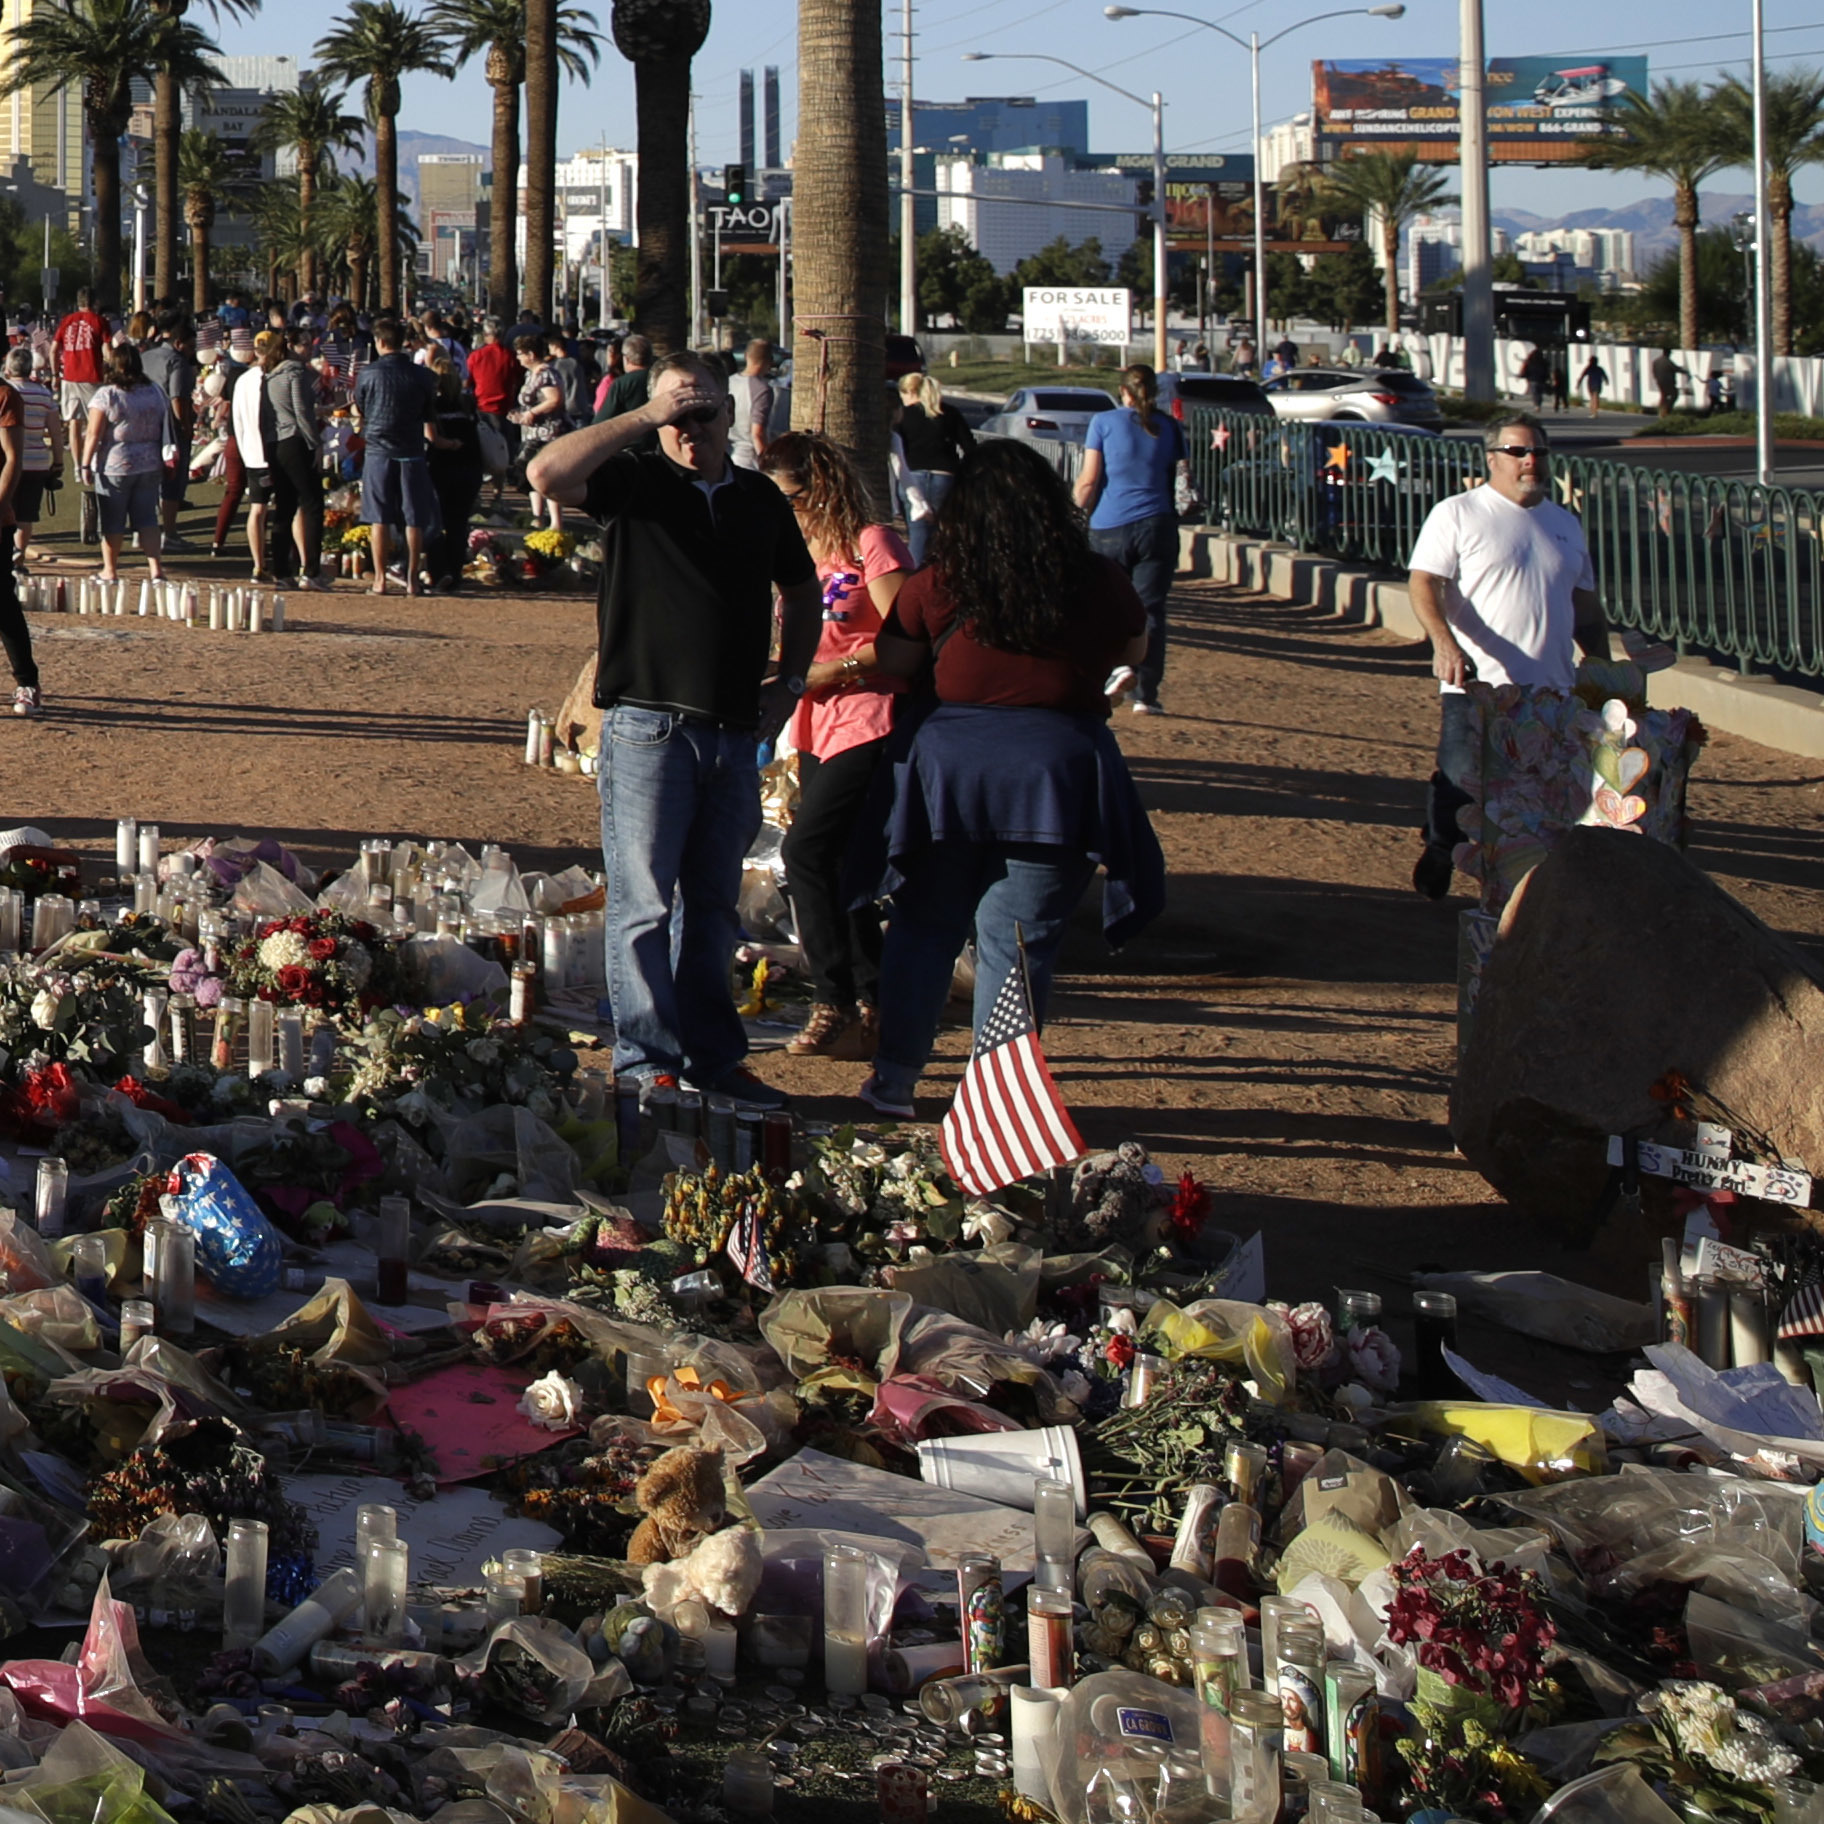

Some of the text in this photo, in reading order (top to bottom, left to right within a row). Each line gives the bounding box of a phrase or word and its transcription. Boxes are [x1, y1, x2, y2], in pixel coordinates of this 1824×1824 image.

[1165, 155, 1226, 168] GRAND
[708, 206, 771, 229] TAO
[1029, 291, 1122, 306] FOR SALE
